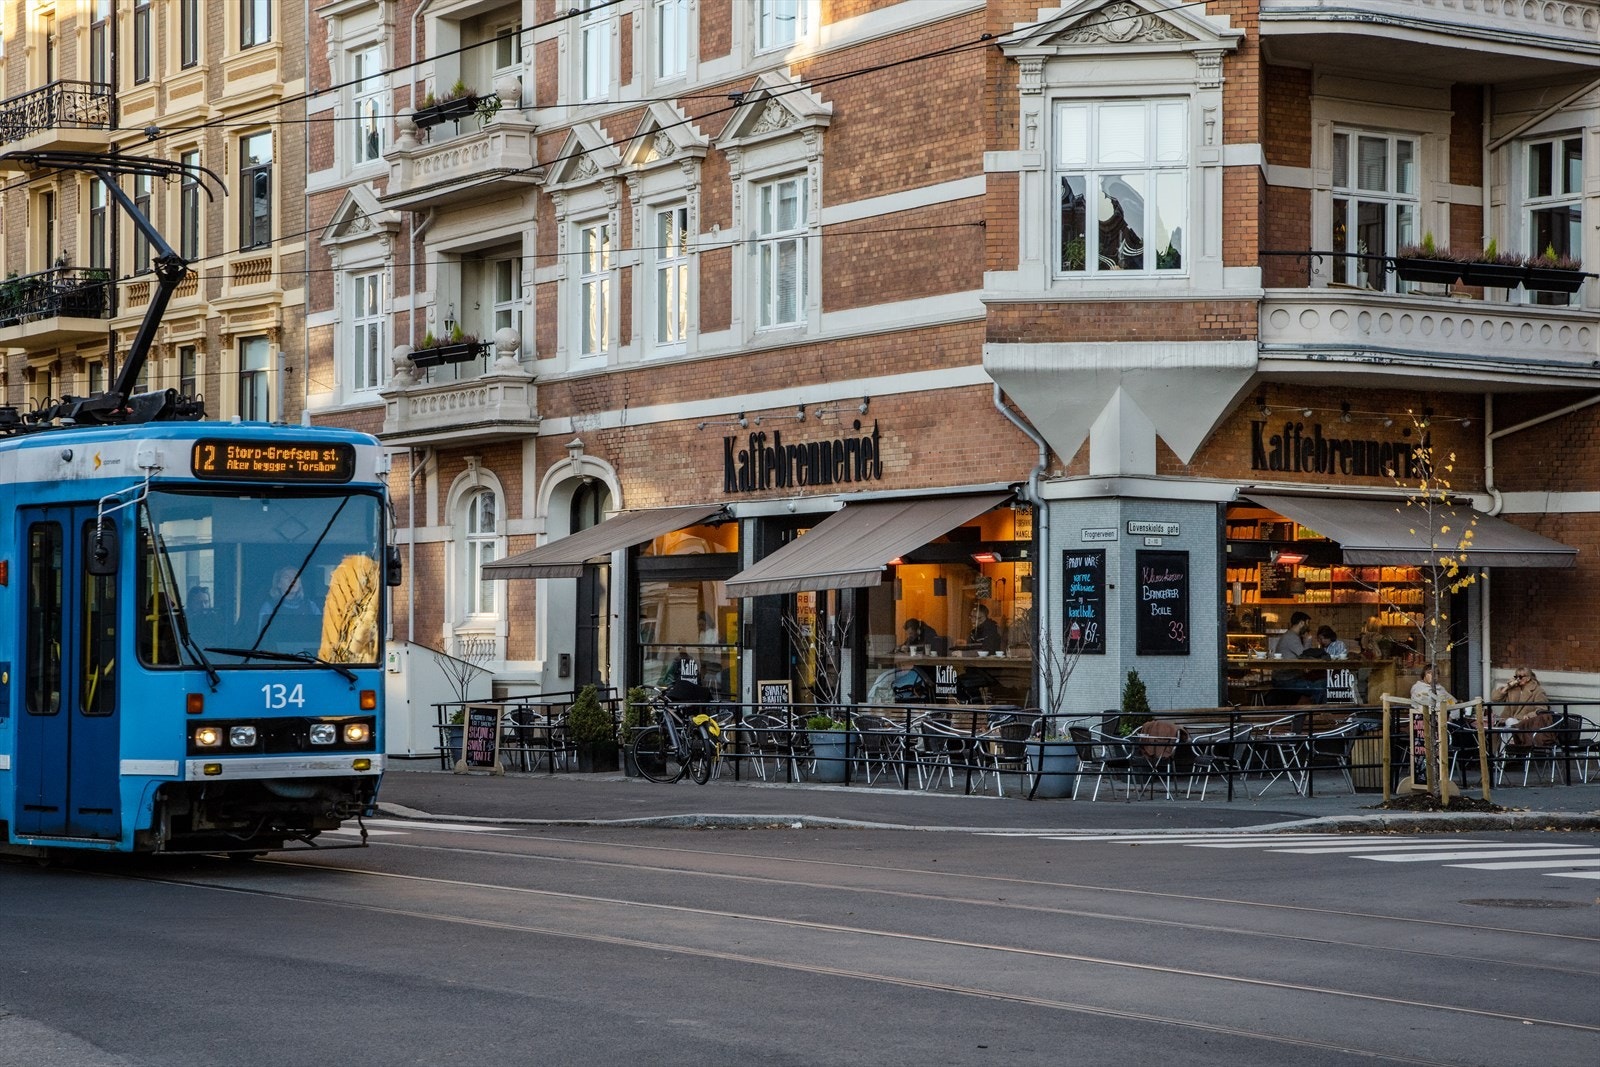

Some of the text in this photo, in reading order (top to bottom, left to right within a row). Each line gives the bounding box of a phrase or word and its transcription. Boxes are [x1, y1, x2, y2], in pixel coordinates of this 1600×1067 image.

[227, 446, 319, 461] Storo-Grefsen
[322, 449, 339, 461] st.
[723, 419, 883, 493] Kaffebrenneriet
[227, 460, 249, 470] Aker
[296, 461, 336, 472] Torshov
[1084, 530, 1115, 539] Frognerveien
[1167, 526, 1179, 535] gate
[1150, 603, 1172, 616] BOLLE
[681, 659, 698, 675] Kaffe
[936, 665, 957, 684] Kaffe
[1327, 669, 1355, 688] Kaffe
[261, 683, 305, 709] 134
[765, 685, 783, 697] SVART
[1327, 689, 1355, 699] brenneriet
[468, 726, 495, 739] SCONES
